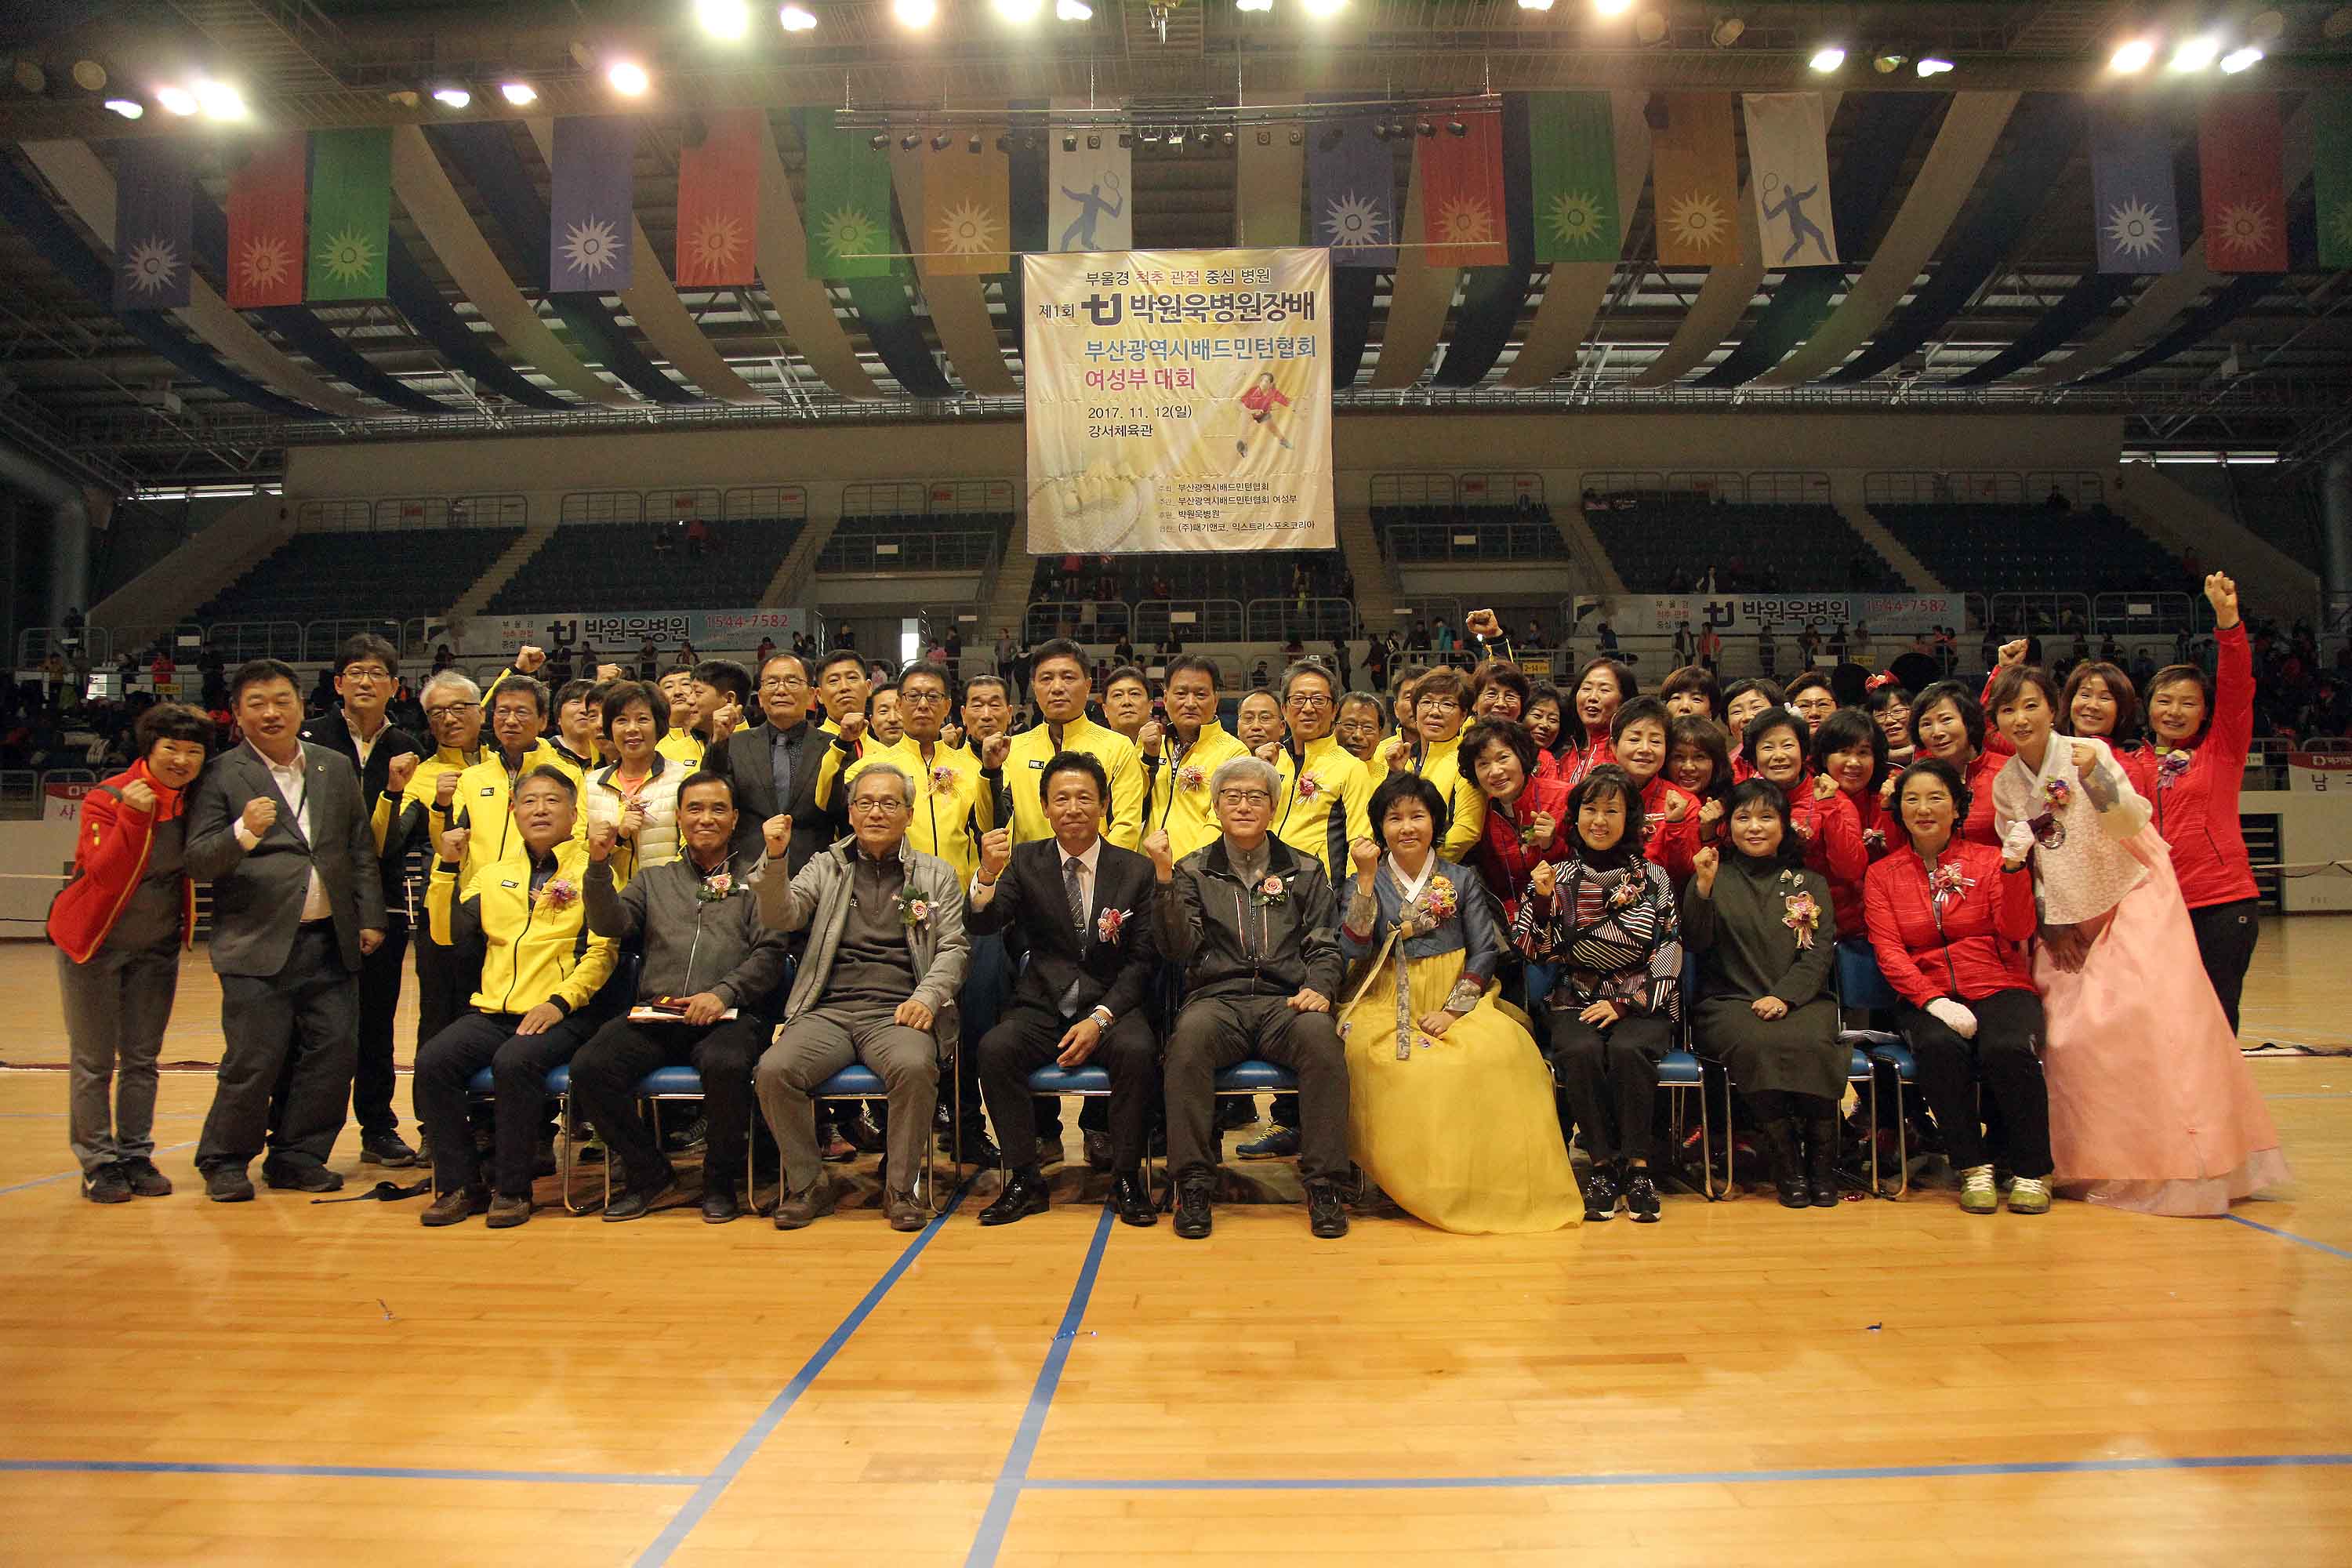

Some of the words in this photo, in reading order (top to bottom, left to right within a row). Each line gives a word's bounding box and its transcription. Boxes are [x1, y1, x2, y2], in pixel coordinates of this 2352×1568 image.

[1085, 271, 1129, 287] 부울경
[1136, 270, 1165, 285] 척추
[1170, 270, 1199, 285] 관절
[1205, 269, 1234, 285] 중심
[1241, 268, 1269, 284] 병원
[1039, 303, 1075, 319] 제1회
[1130, 291, 1315, 324] 박원욱병원장배
[1085, 336, 1316, 362] 부산광역시배드민턴협회
[1085, 368, 1149, 391] 여성부
[1154, 367, 1195, 390] 대회
[1088, 407, 1123, 419] 2017.
[1129, 407, 1149, 419] 11.
[1155, 405, 1192, 419] 12(일)
[1088, 424, 1153, 438] 강서체육관
[1178, 482, 1269, 492] 부산광역시배드민턴협회
[1178, 495, 1269, 506] 부산광역시배드민턴협회
[1272, 495, 1298, 504] 여성부
[1178, 510, 1221, 519] 박원욱병원
[1742, 600, 1849, 626] 박원욱병원
[1867, 599, 1947, 612] 1544-7582
[584, 617, 690, 644] 박원욱병원
[706, 614, 790, 628] 1544-7582
[2311, 772, 2328, 792] 남
